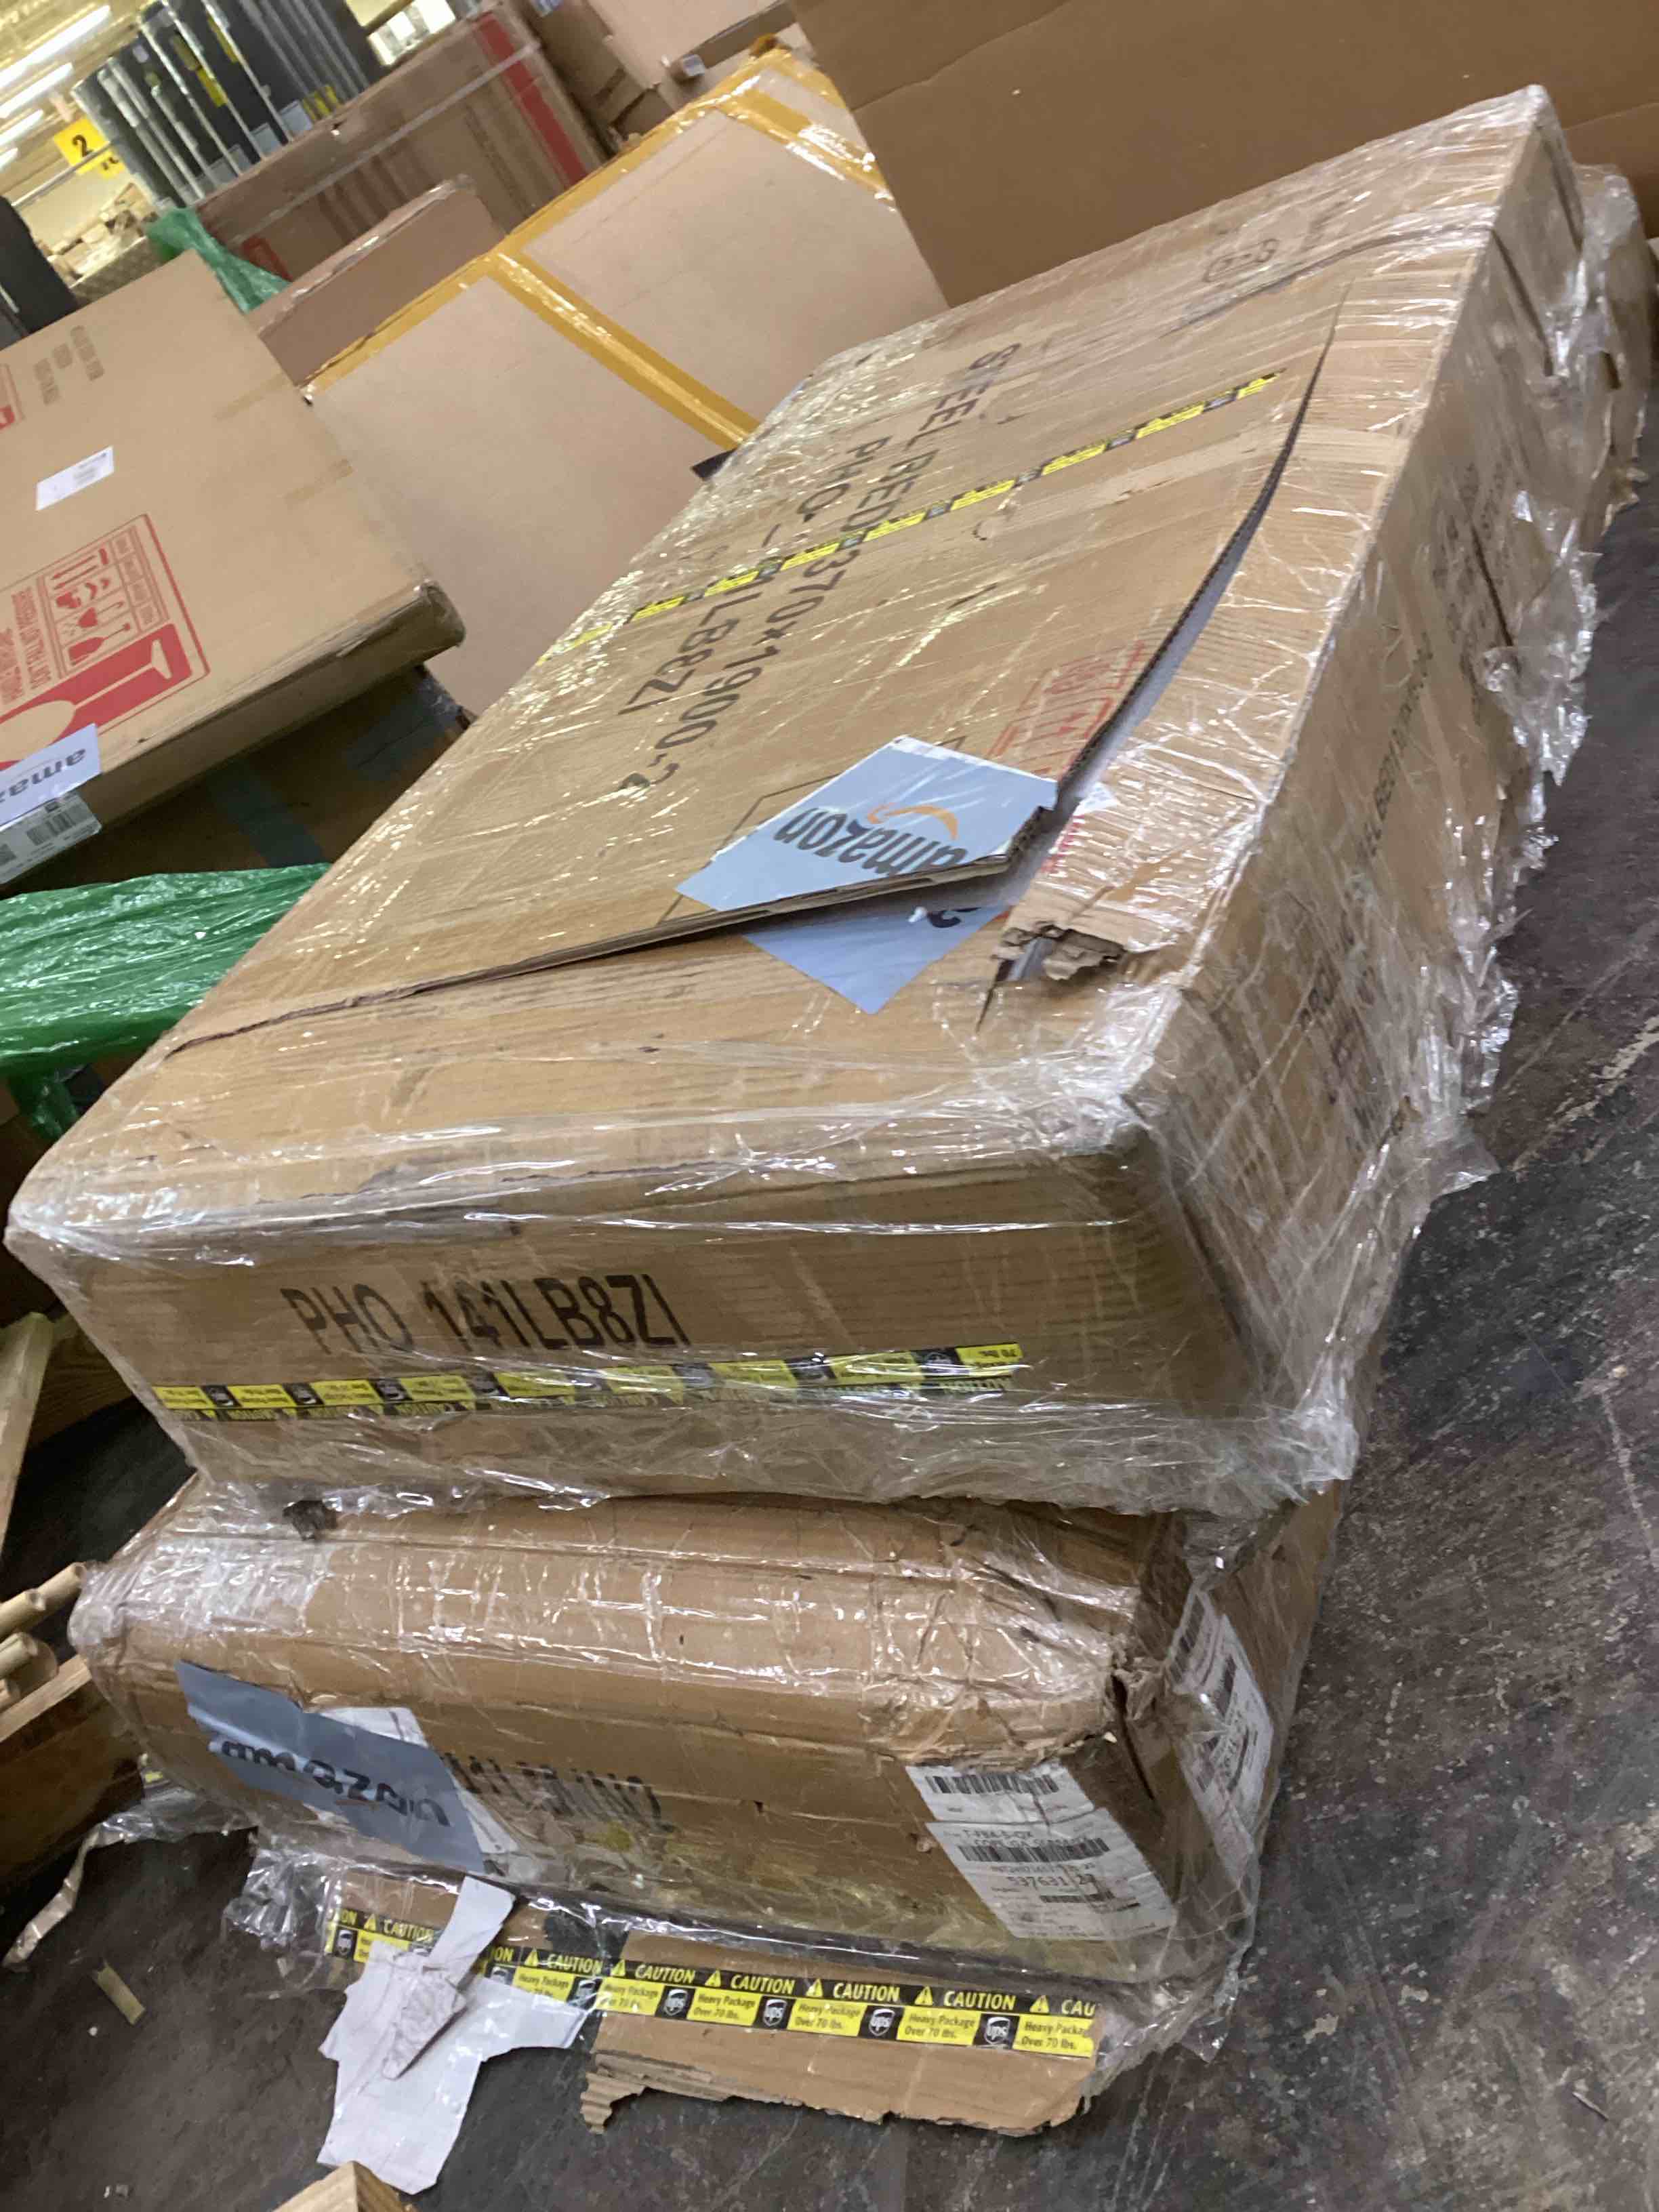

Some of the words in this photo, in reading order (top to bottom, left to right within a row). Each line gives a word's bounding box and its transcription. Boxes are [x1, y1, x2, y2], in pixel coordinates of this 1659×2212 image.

[903, 343, 1021, 452] SEEL
[773, 807, 968, 876] amazon
[279, 1284, 413, 1354] PHO
[547, 1954, 604, 1975] CAUTION
[634, 1964, 696, 1984] CAUTION
[730, 1975, 796, 1994] CAUTION
[833, 1982, 901, 2002] CAUTION
[943, 1990, 1017, 2011] CAUTION
[698, 1994, 721, 2005] Heavy
[693, 2007, 711, 2016] Over
[909, 2013, 936, 2026] Heavy
[905, 2025, 925, 2036] Over
[1025, 2022, 1052, 2035] Heavy
[1021, 2036, 1042, 2047] Over
